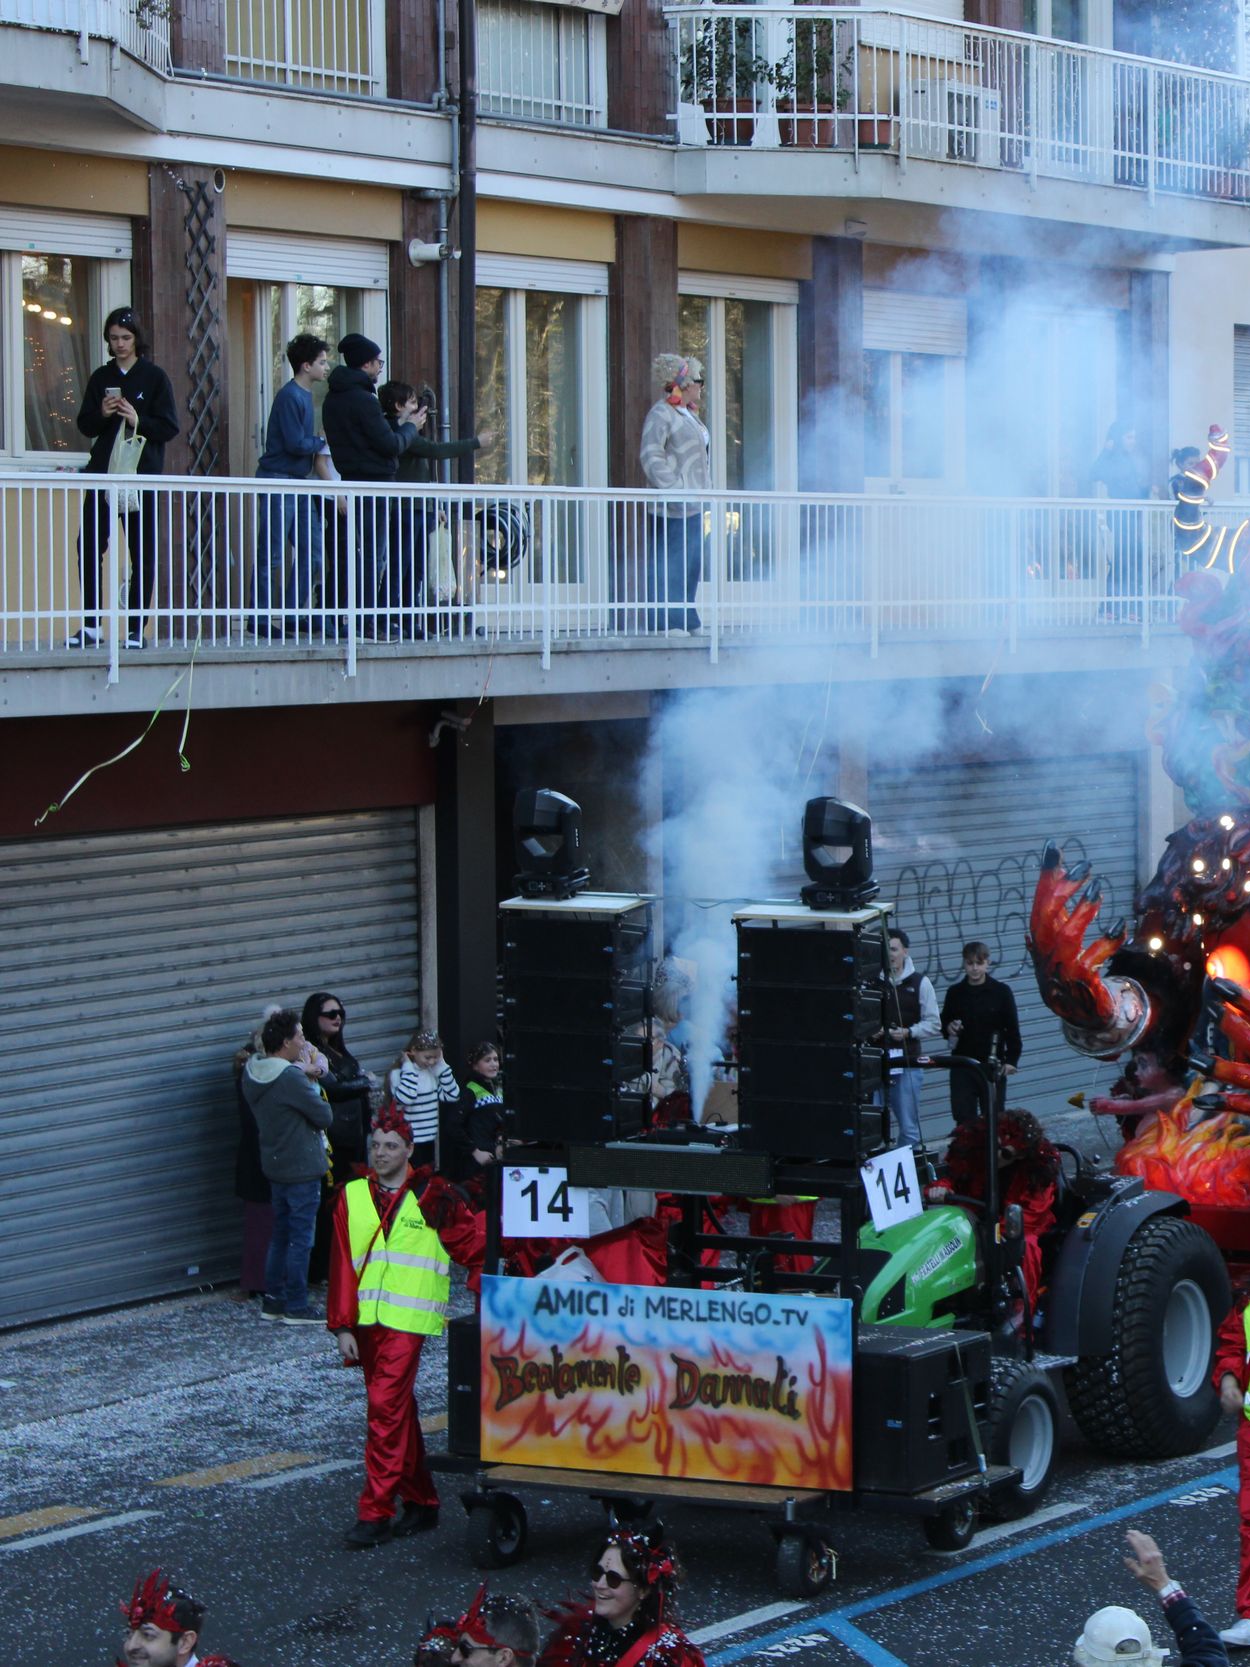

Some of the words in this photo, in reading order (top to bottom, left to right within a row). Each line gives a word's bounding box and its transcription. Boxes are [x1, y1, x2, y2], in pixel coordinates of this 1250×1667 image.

[521, 1179, 574, 1222] 14
[876, 1161, 911, 1210] 14
[533, 1285, 609, 1317] AMICI
[617, 1294, 635, 1318] di
[668, 1352, 801, 1421] Dannati
